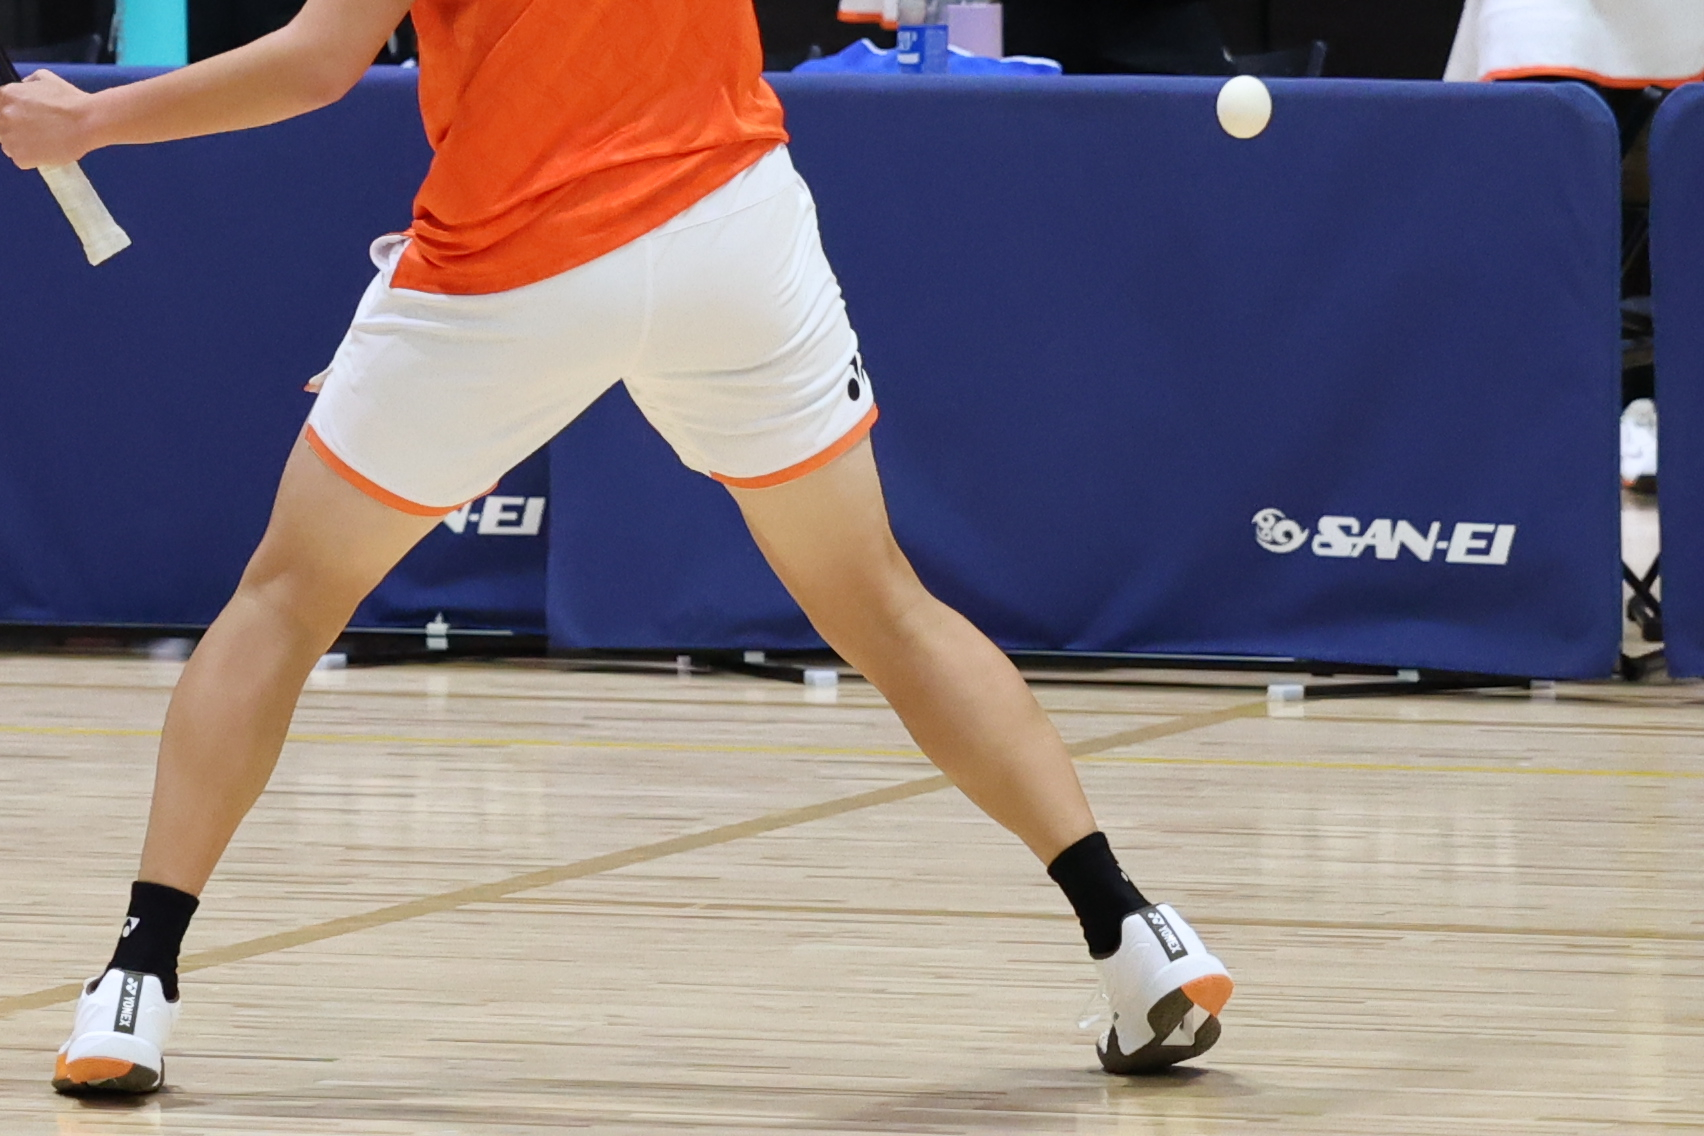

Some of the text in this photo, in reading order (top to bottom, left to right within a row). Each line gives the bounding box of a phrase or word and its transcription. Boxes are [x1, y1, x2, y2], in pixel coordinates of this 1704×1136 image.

[1311, 515, 1516, 565] SAN-EI
[1158, 924, 1182, 954] YONEX
[118, 996, 136, 1027] YONEX
